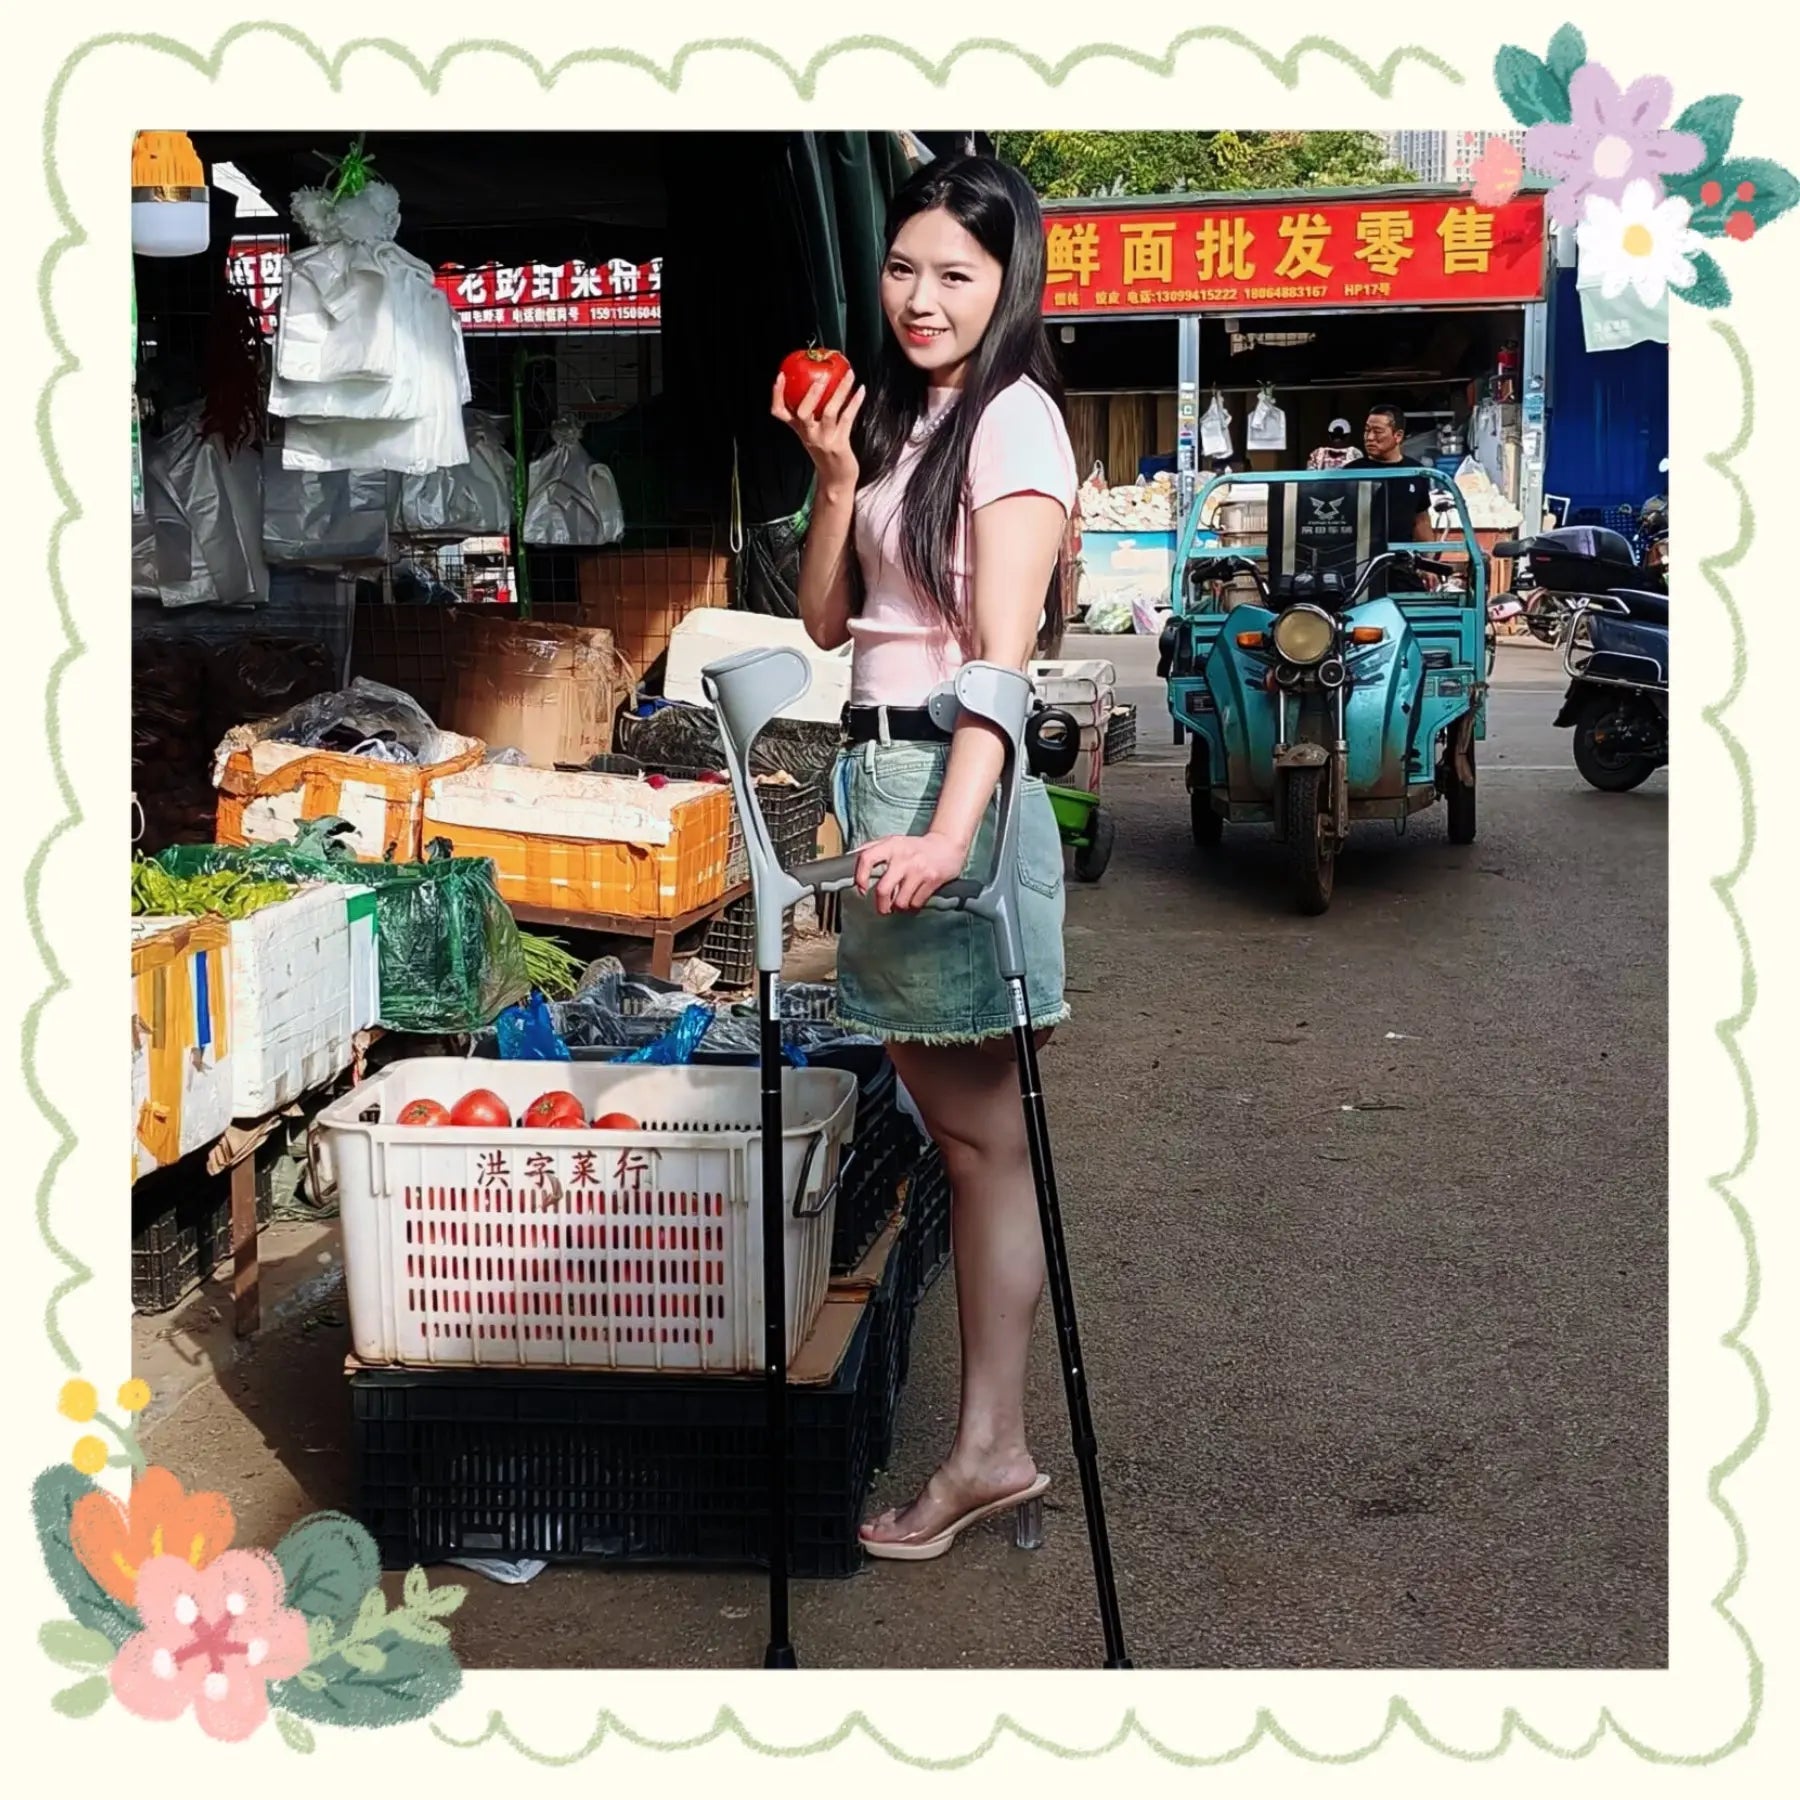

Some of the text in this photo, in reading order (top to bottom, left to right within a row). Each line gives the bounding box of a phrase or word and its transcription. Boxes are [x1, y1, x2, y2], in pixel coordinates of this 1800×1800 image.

[1046, 206, 1495, 286] 鲜面批发零售
[1344, 282, 1390, 297] HP17号
[476, 1147, 649, 1190] 洪字菜行
